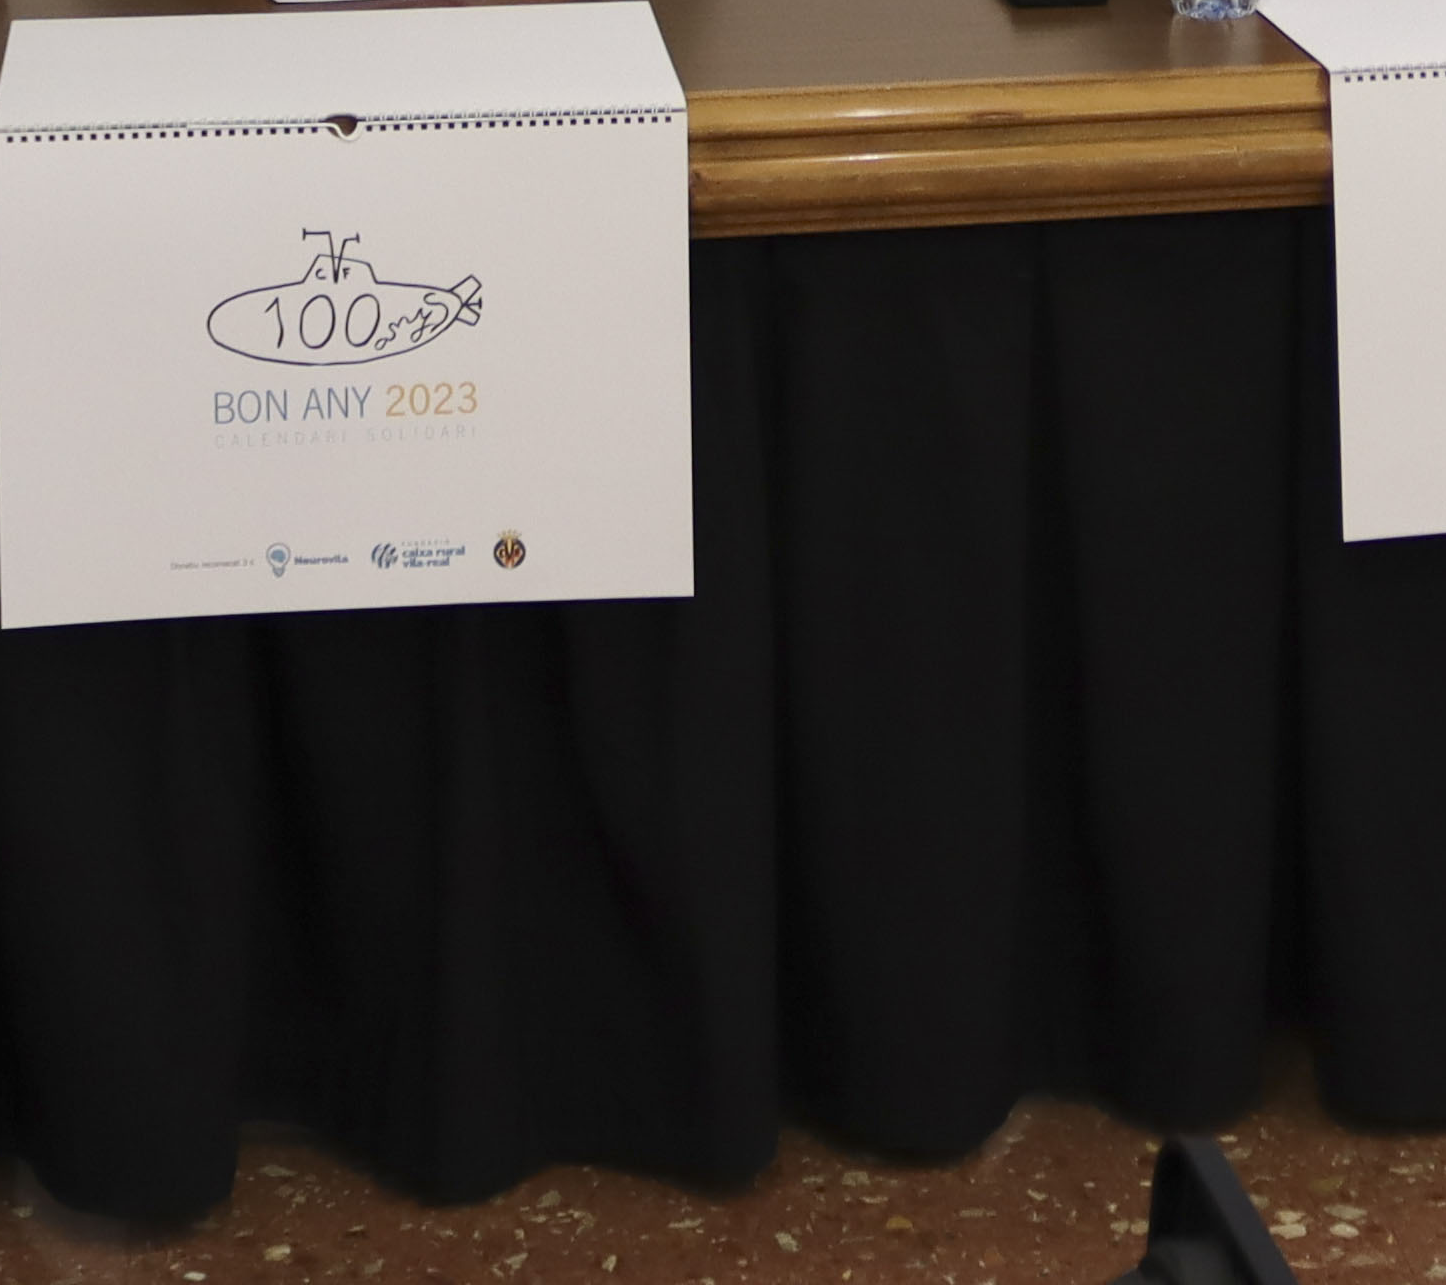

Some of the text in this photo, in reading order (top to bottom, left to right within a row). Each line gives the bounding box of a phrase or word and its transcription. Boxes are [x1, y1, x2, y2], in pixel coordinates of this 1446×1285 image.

[214, 381, 479, 425] BON ANY 2023
